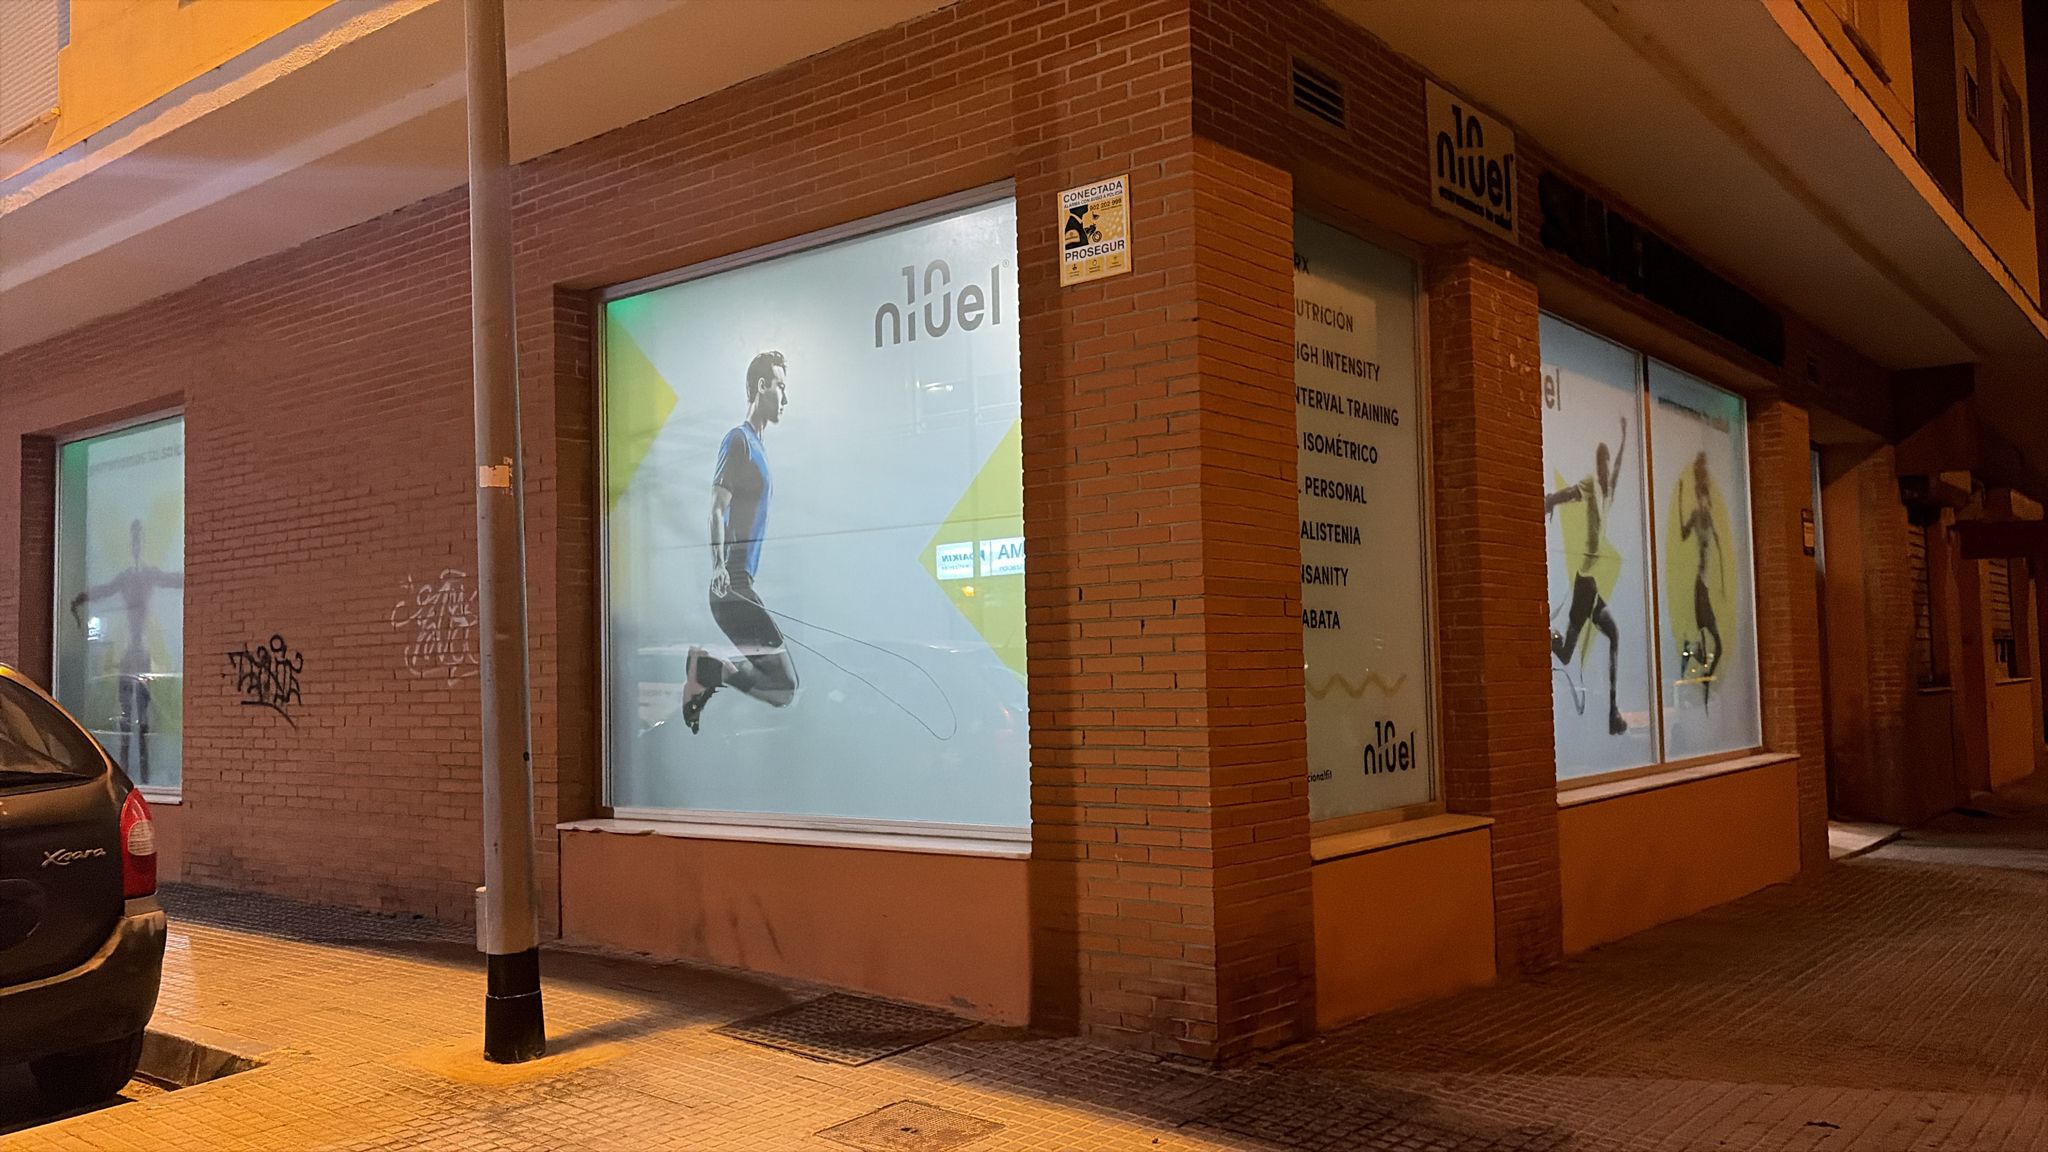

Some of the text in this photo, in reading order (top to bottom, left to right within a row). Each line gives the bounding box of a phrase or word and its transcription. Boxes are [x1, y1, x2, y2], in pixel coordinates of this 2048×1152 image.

[1063, 181, 1122, 203] CONECTADA
[1101, 200, 1111, 209] 202
[1065, 239, 1125, 262] PROSEGUR
[1296, 298, 1353, 333] UTRICIÓN
[1296, 341, 1380, 382] IGH INTENSITY
[1347, 398, 1399, 427] TRAINING
[1303, 431, 1378, 464] ISOMÉTRICO
[1305, 476, 1367, 504] PERSONAL
[1301, 520, 1361, 545] ALISTENIA
[1302, 609, 1341, 629] ABATA
[41, 847, 106, 868] Xsara
